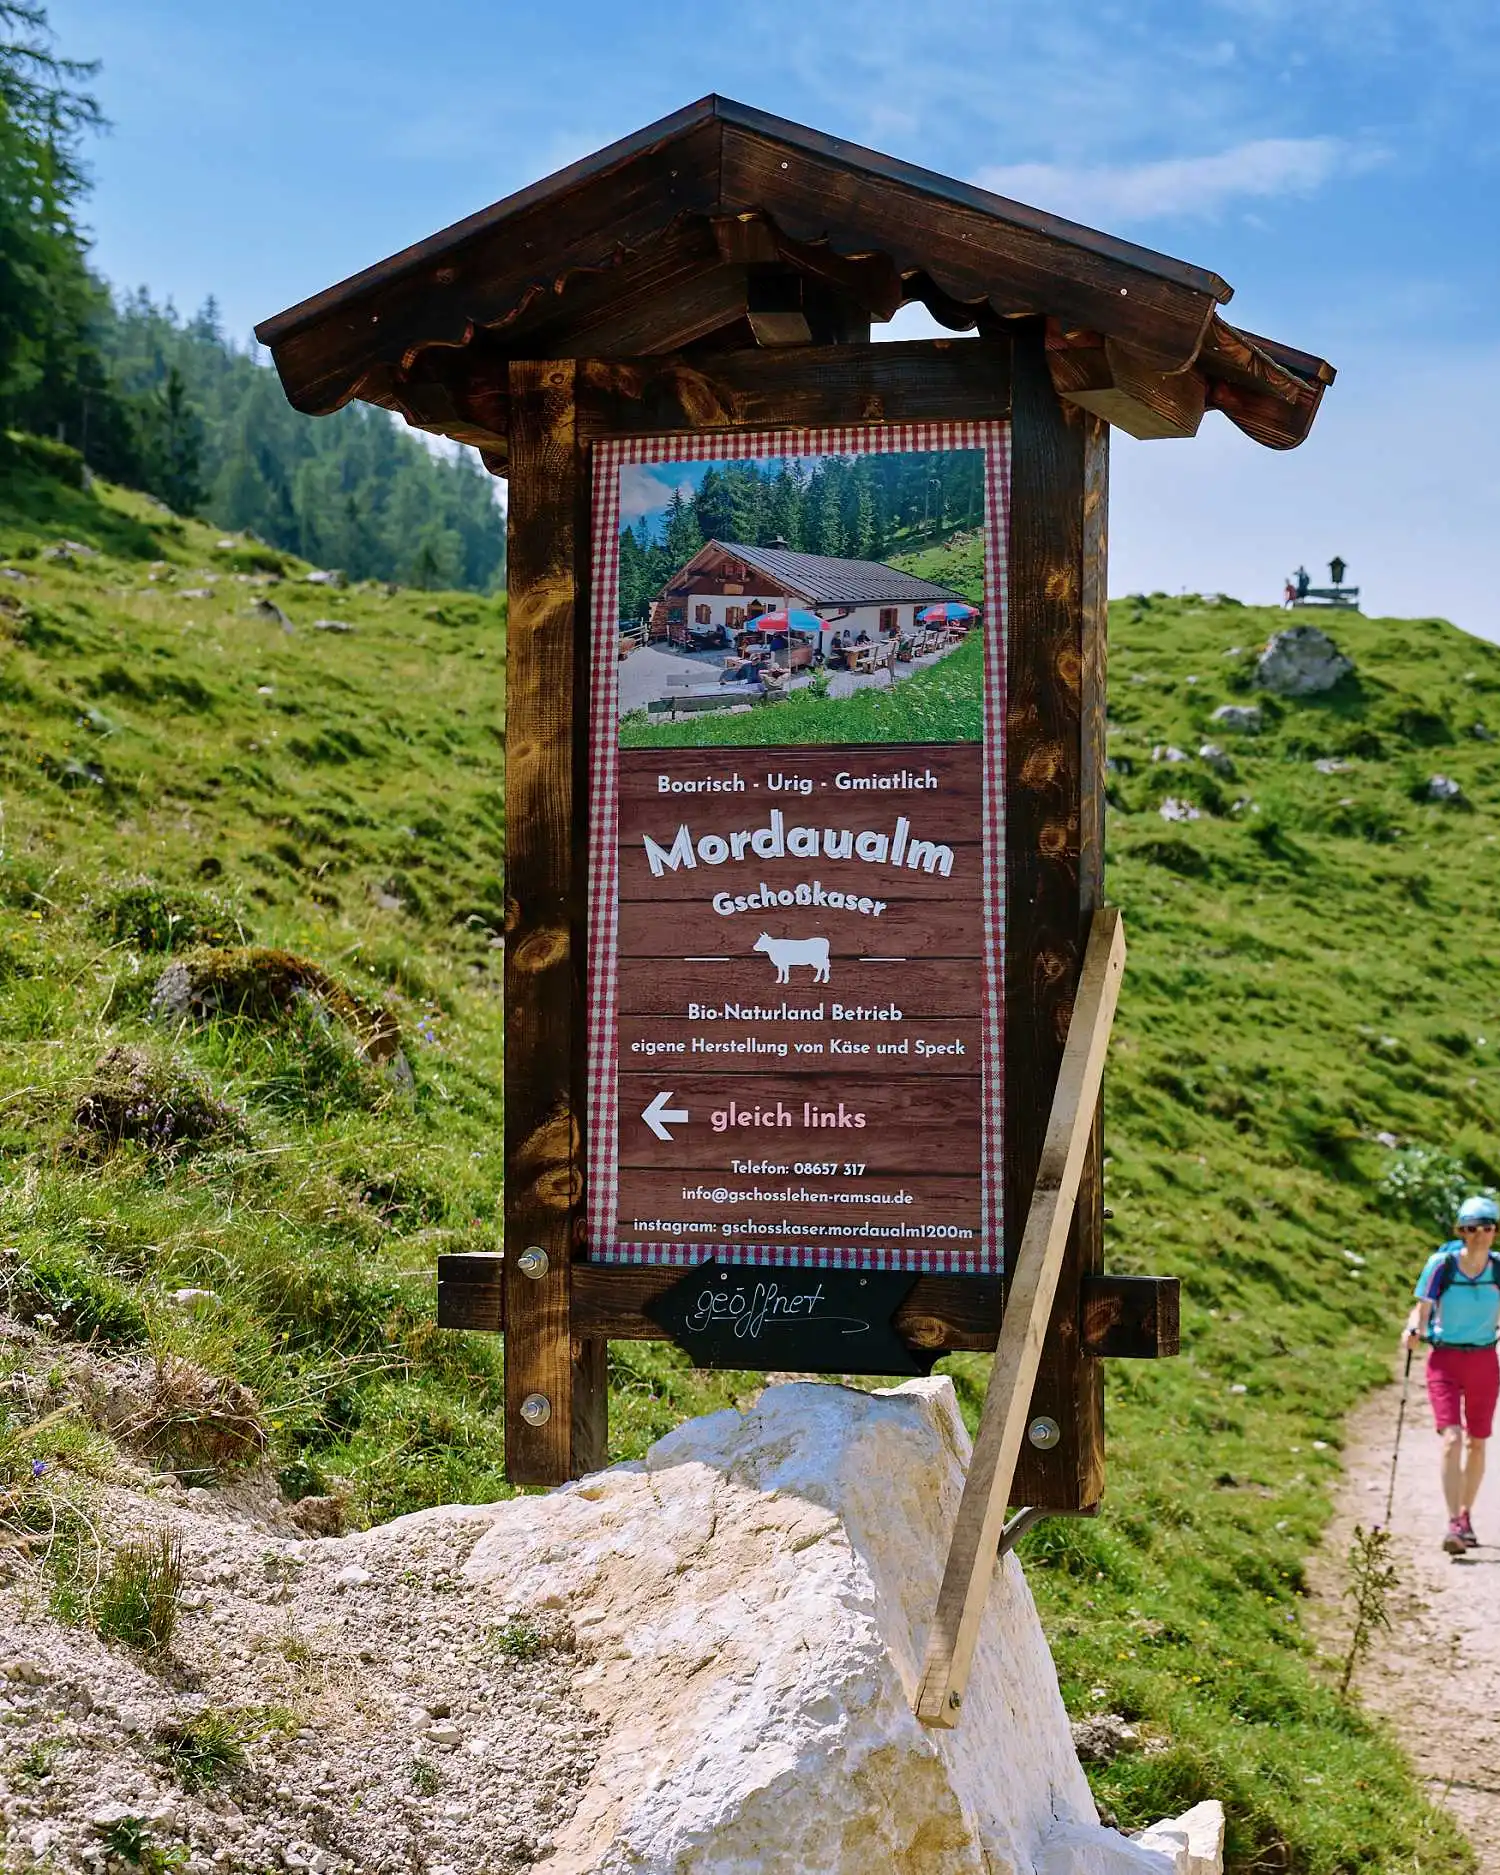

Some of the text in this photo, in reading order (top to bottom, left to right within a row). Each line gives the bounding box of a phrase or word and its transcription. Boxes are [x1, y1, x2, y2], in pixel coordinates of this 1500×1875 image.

[658, 773, 745, 793] Boarisch
[767, 773, 813, 795] Urig
[835, 770, 938, 790] Gmiatlich
[642, 809, 955, 877] Mordaualm
[712, 880, 888, 917] Gschoßkaser
[688, 1003, 903, 1021] Bio-Naturland Betrieb
[631, 1037, 965, 1058] eigene Herstellung von Käse und Speck
[711, 1101, 867, 1132] gleich links
[731, 1160, 866, 1176] Telefon: 08657 317
[682, 1186, 914, 1205] info@gschosslehen-ramsau.de
[633, 1218, 973, 1239] instagram: gschosskaser.mordaualm1200m
